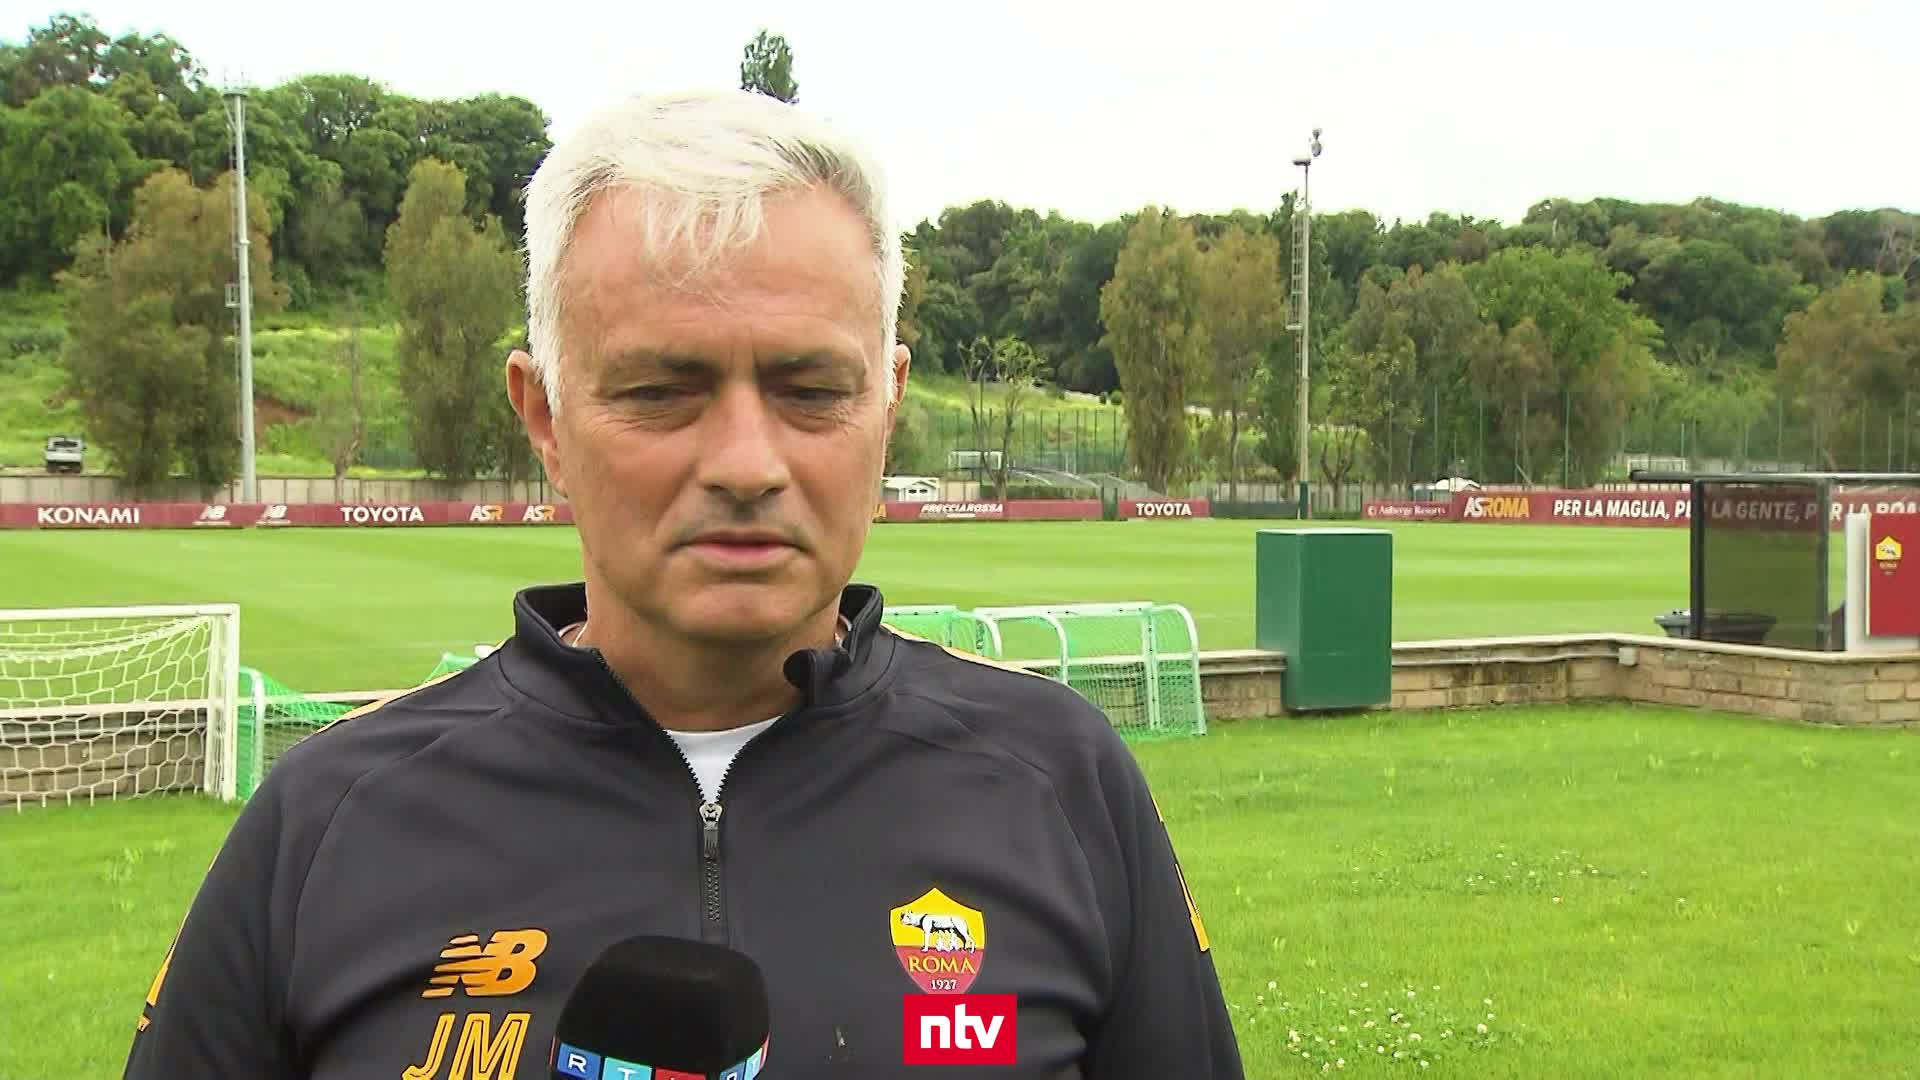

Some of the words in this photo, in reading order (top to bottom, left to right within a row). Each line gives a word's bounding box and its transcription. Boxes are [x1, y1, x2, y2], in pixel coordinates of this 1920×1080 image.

[37, 507, 140, 524] KONAMI
[340, 507, 425, 522] TOYOTA
[1135, 503, 1192, 516] TOYOTA
[1553, 499, 1582, 516] PER
[1584, 500, 1603, 517] LA
[1606, 500, 1670, 520] MAGLIA,
[1711, 502, 1731, 518] LA
[1736, 502, 1800, 522] GENTE,
[1805, 503, 1844, 521] PR
[907, 955, 976, 975] ROMA
[930, 979, 957, 990] 1927
[401, 1012, 532, 1080] JM
